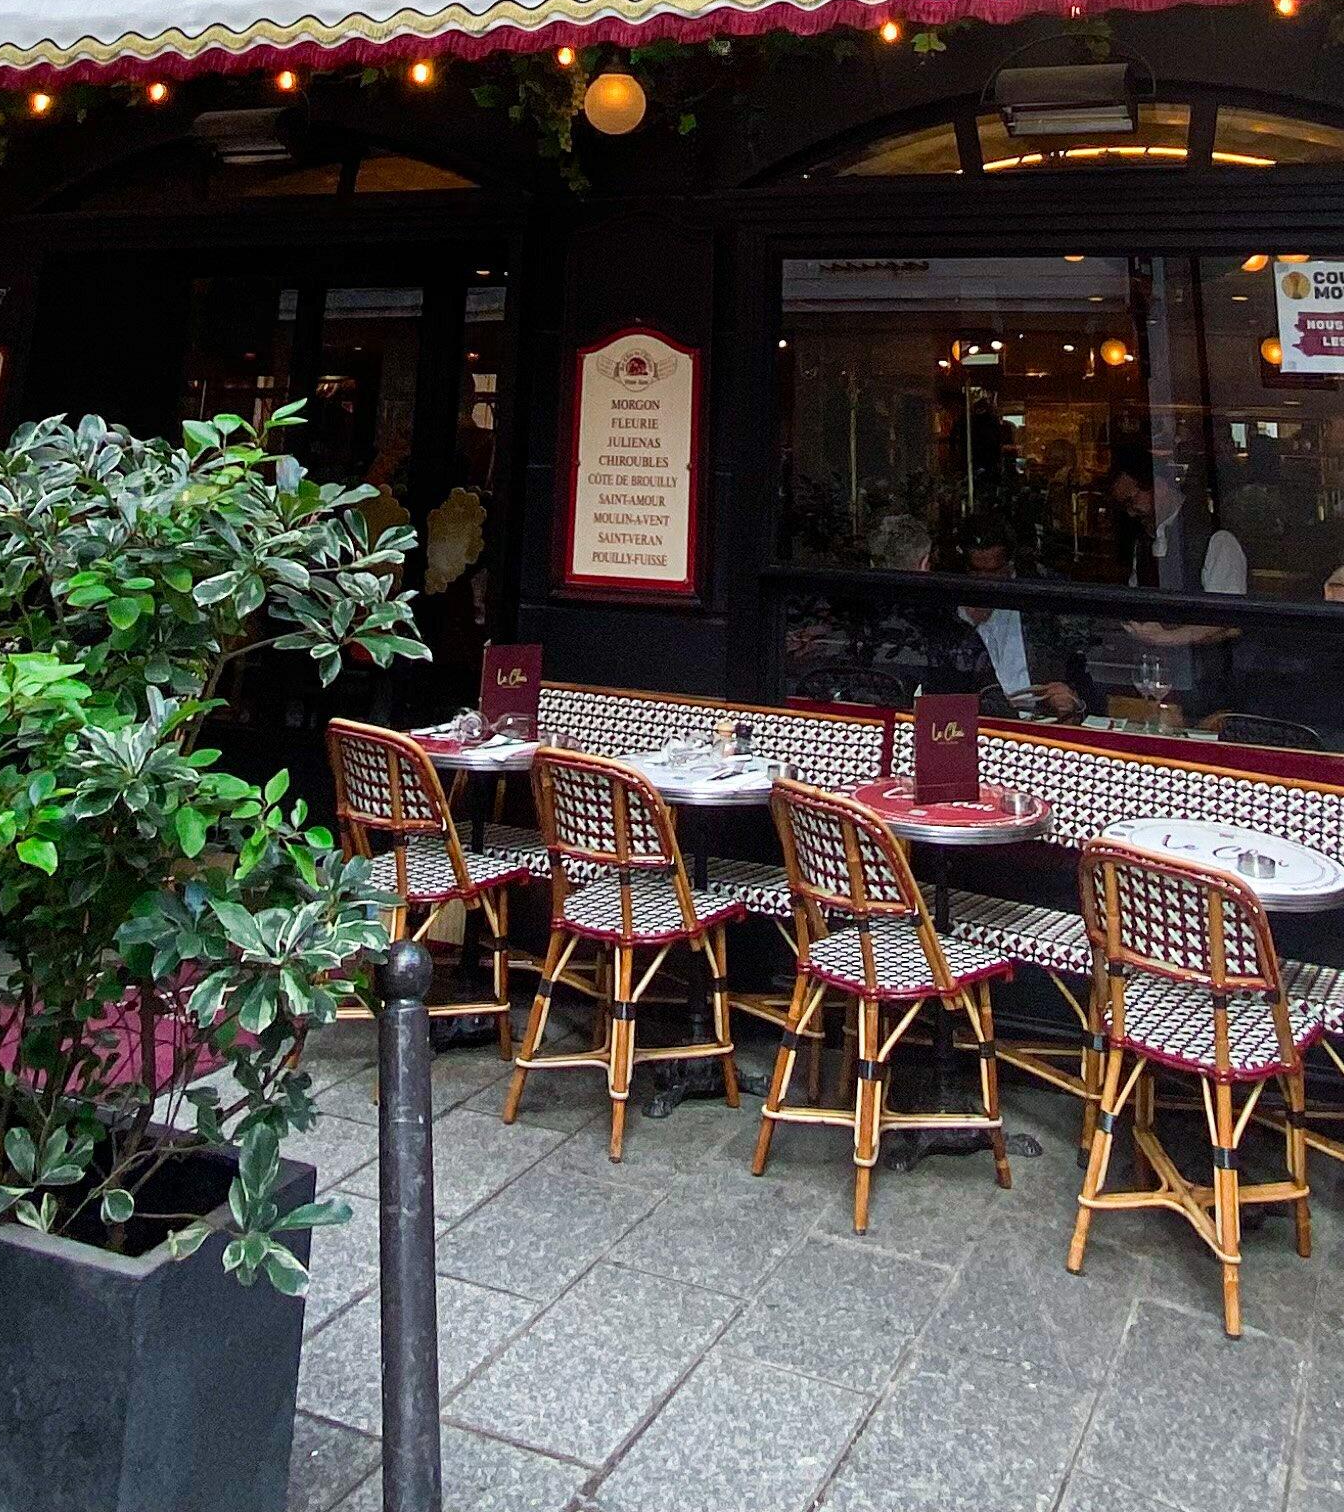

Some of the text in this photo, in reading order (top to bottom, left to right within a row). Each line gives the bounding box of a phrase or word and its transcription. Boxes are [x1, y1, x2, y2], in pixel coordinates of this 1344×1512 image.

[1306, 319, 1344, 331] NOUS
[610, 399, 661, 411] MORGON
[610, 417, 659, 430] FLEURIE
[606, 436, 661, 449] JULIENAS
[598, 454, 669, 468] CHIROUBLES
[615, 474, 629, 487] DE
[630, 475, 678, 489] BROUILLY
[598, 492, 666, 507] SAINT-AMOUR
